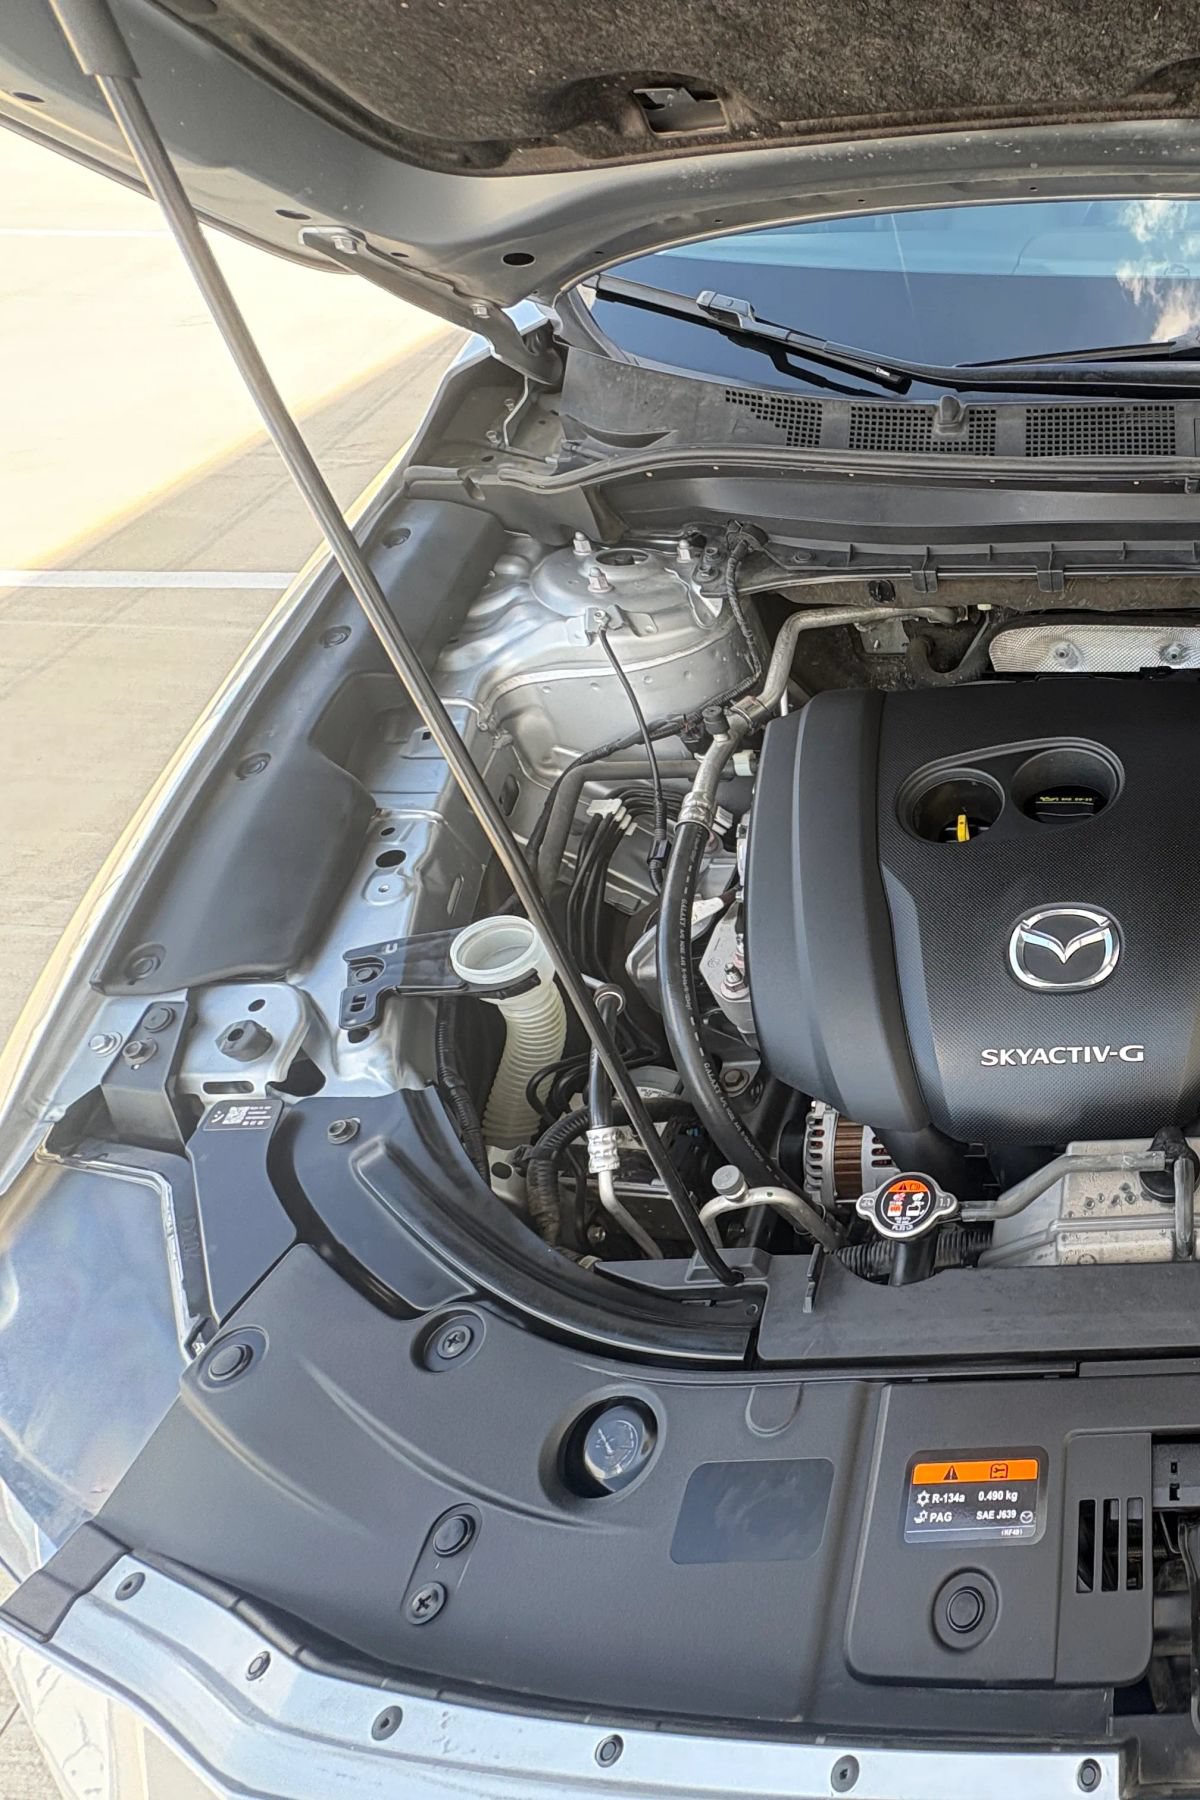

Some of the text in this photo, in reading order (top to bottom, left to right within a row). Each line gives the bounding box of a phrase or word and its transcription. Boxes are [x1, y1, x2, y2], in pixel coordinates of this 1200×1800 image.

[679, 898, 687, 928] GALAXY
[980, 1045, 1144, 1066] SKYACTIV-G
[703, 1062, 721, 1094] GALAXY
[931, 1490, 1018, 1504] R-134a 0.490 kg
[929, 1509, 1017, 1522] PAG SAE J639
